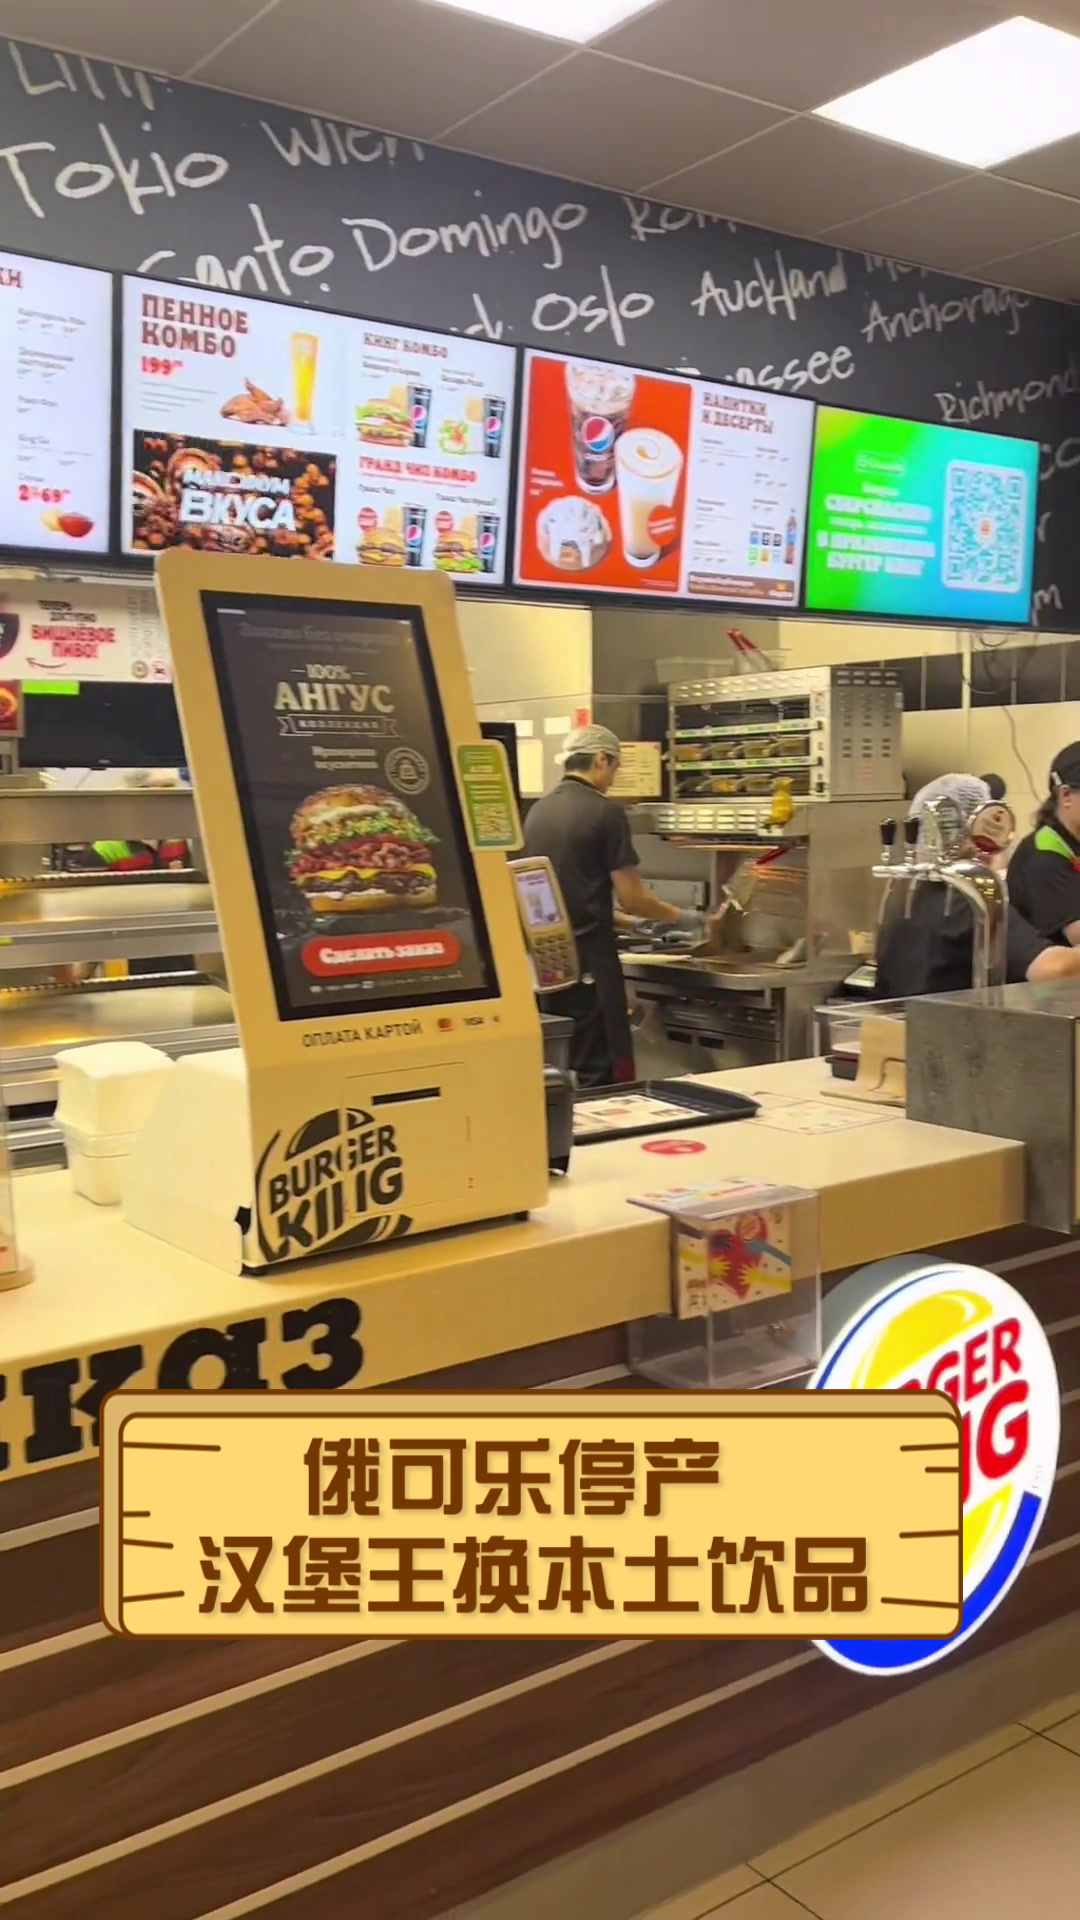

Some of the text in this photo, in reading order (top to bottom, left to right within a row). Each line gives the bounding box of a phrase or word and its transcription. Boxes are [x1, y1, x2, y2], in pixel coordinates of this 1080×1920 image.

[0, 123, 228, 218] Tokio
[341, 202, 588, 272] Domingo
[531, 264, 655, 347] Oslo
[691, 249, 848, 320] Auckland
[142, 293, 248, 334] ПЕННОЕ
[142, 321, 235, 358] КОМБО
[179, 487, 297, 532] ВКУСА
[274, 681, 396, 713] АНГУС
[305, 663, 351, 680] 100%
[302, 1018, 424, 1048] ОПЛАТА КАРТОЙ
[269, 1124, 398, 1216] BURGER
[0, 1297, 365, 1473] каз
